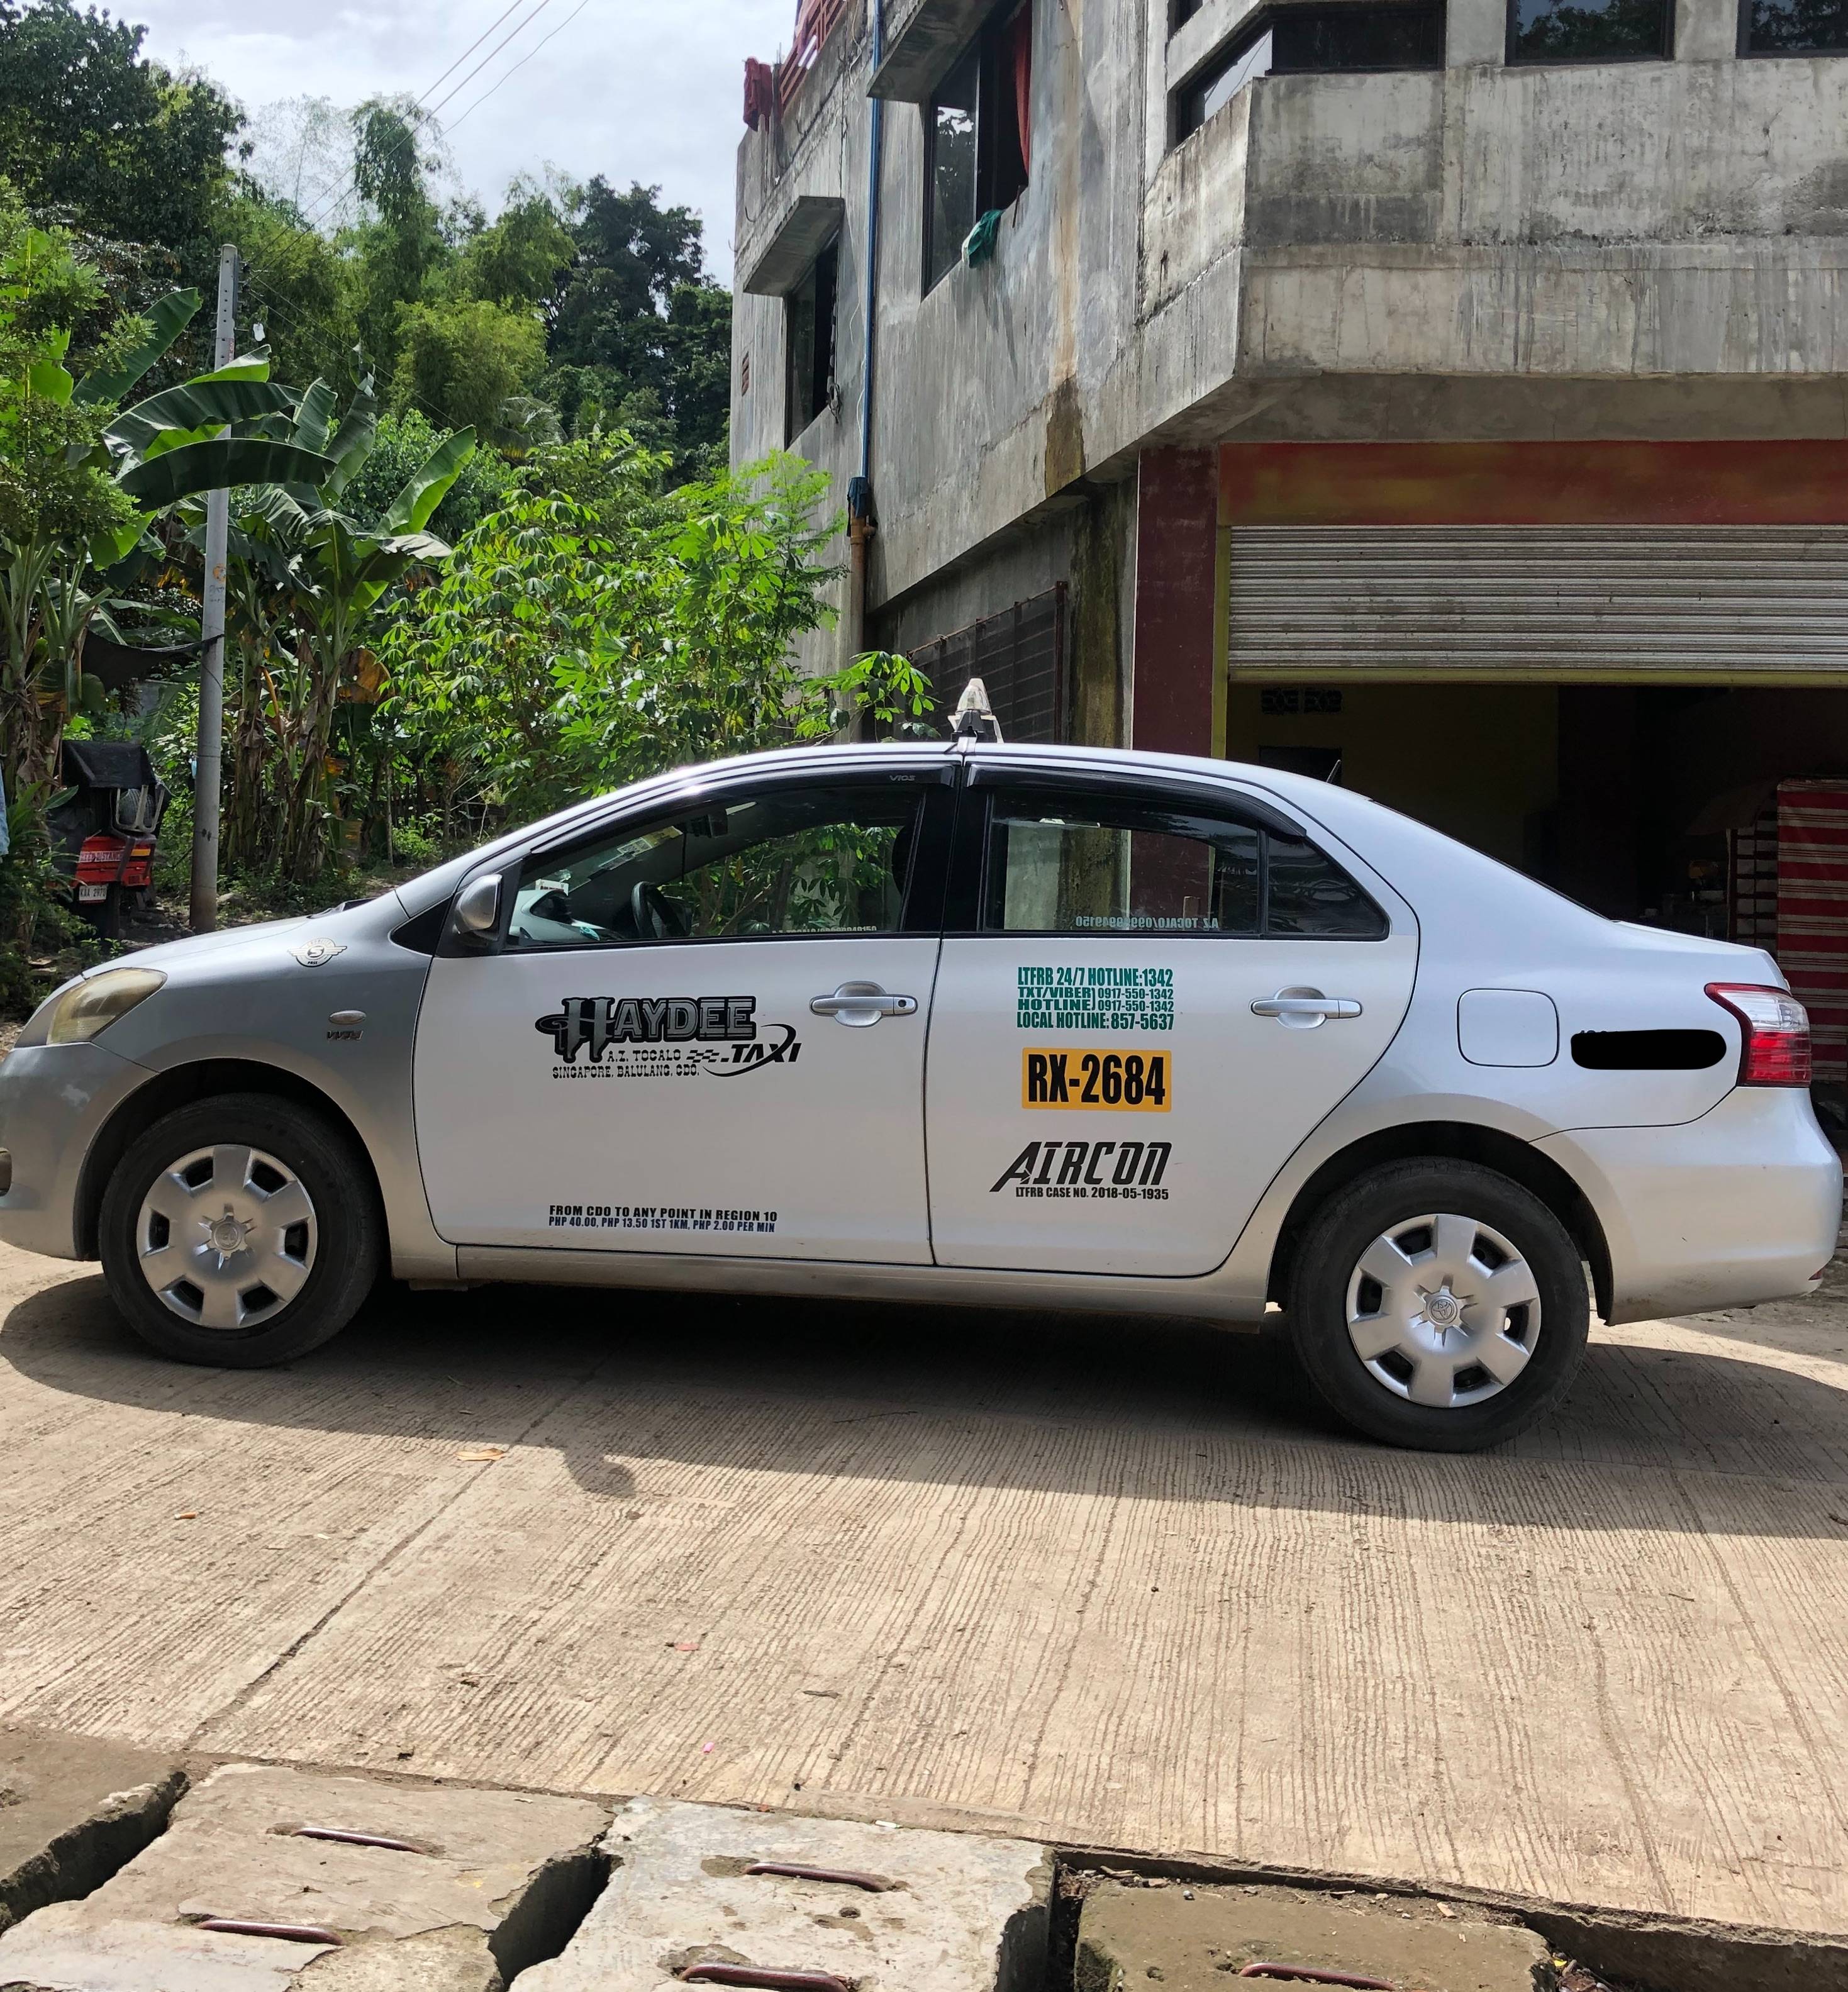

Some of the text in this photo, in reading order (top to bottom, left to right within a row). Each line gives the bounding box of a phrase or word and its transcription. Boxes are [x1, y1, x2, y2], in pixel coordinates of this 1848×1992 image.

[1017, 967, 1054, 986] LTFRB
[1057, 967, 1085, 986] 24/7
[1098, 988, 1174, 999] 0917-550-1342
[1098, 1000, 1174, 1012] 0917-550-1342
[1016, 1012, 1174, 1030] LOCAL HOTLINE: 857-5637
[535, 996, 756, 1064] HAYDEE
[633, 1049, 681, 1062] TOCALO
[1028, 1054, 1166, 1105] RX-2684
[989, 1142, 1172, 1192] AIRCON
[1016, 1187, 1169, 1200] LTFRB CASE NO. 2018-05-1935
[549, 1205, 777, 1221] FROM CDO TO ANY POINT IN REGION 10
[548, 1216, 775, 1233] PHP 40.00, PHP 13.50 1ST 1KM, PHP 2.00 PER MIN
